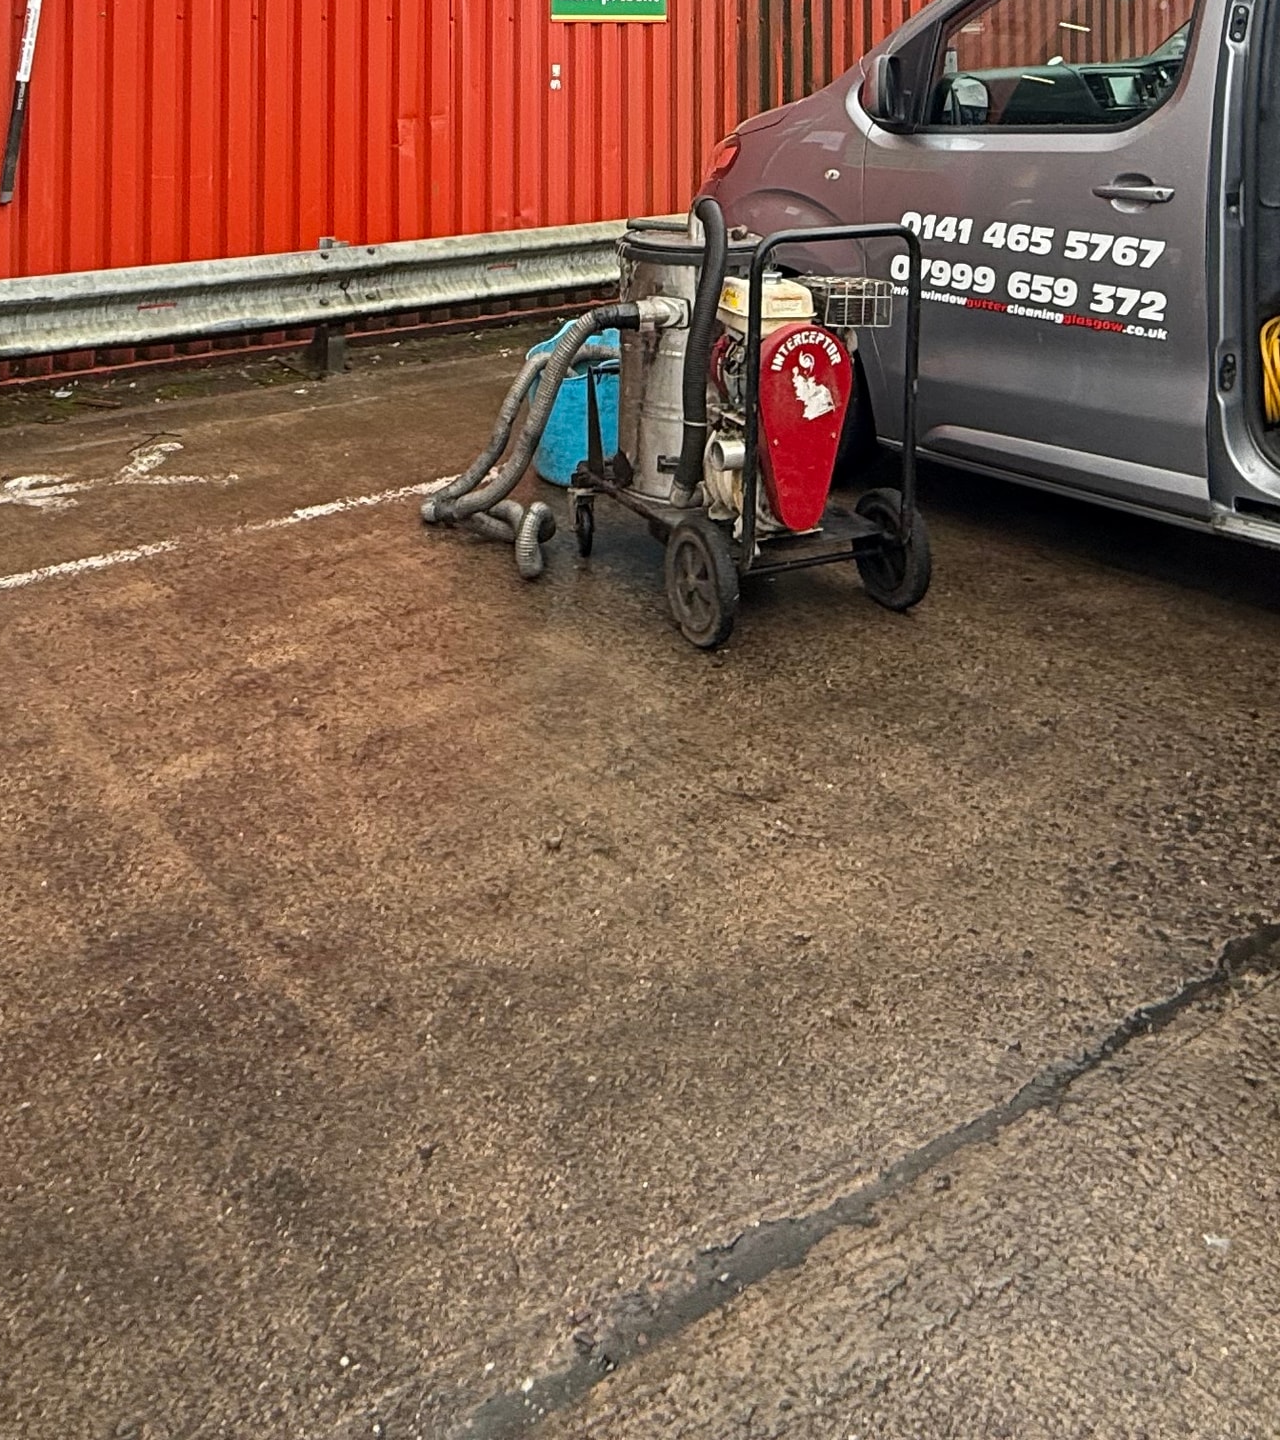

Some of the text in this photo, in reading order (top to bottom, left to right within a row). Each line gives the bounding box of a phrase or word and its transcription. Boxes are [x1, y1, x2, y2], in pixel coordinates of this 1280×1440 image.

[901, 211, 1166, 269] 0141 465 5767
[1007, 271, 1078, 307] 659
[1089, 283, 1167, 322] 372
[770, 330, 842, 372] INTERCEPTOR
